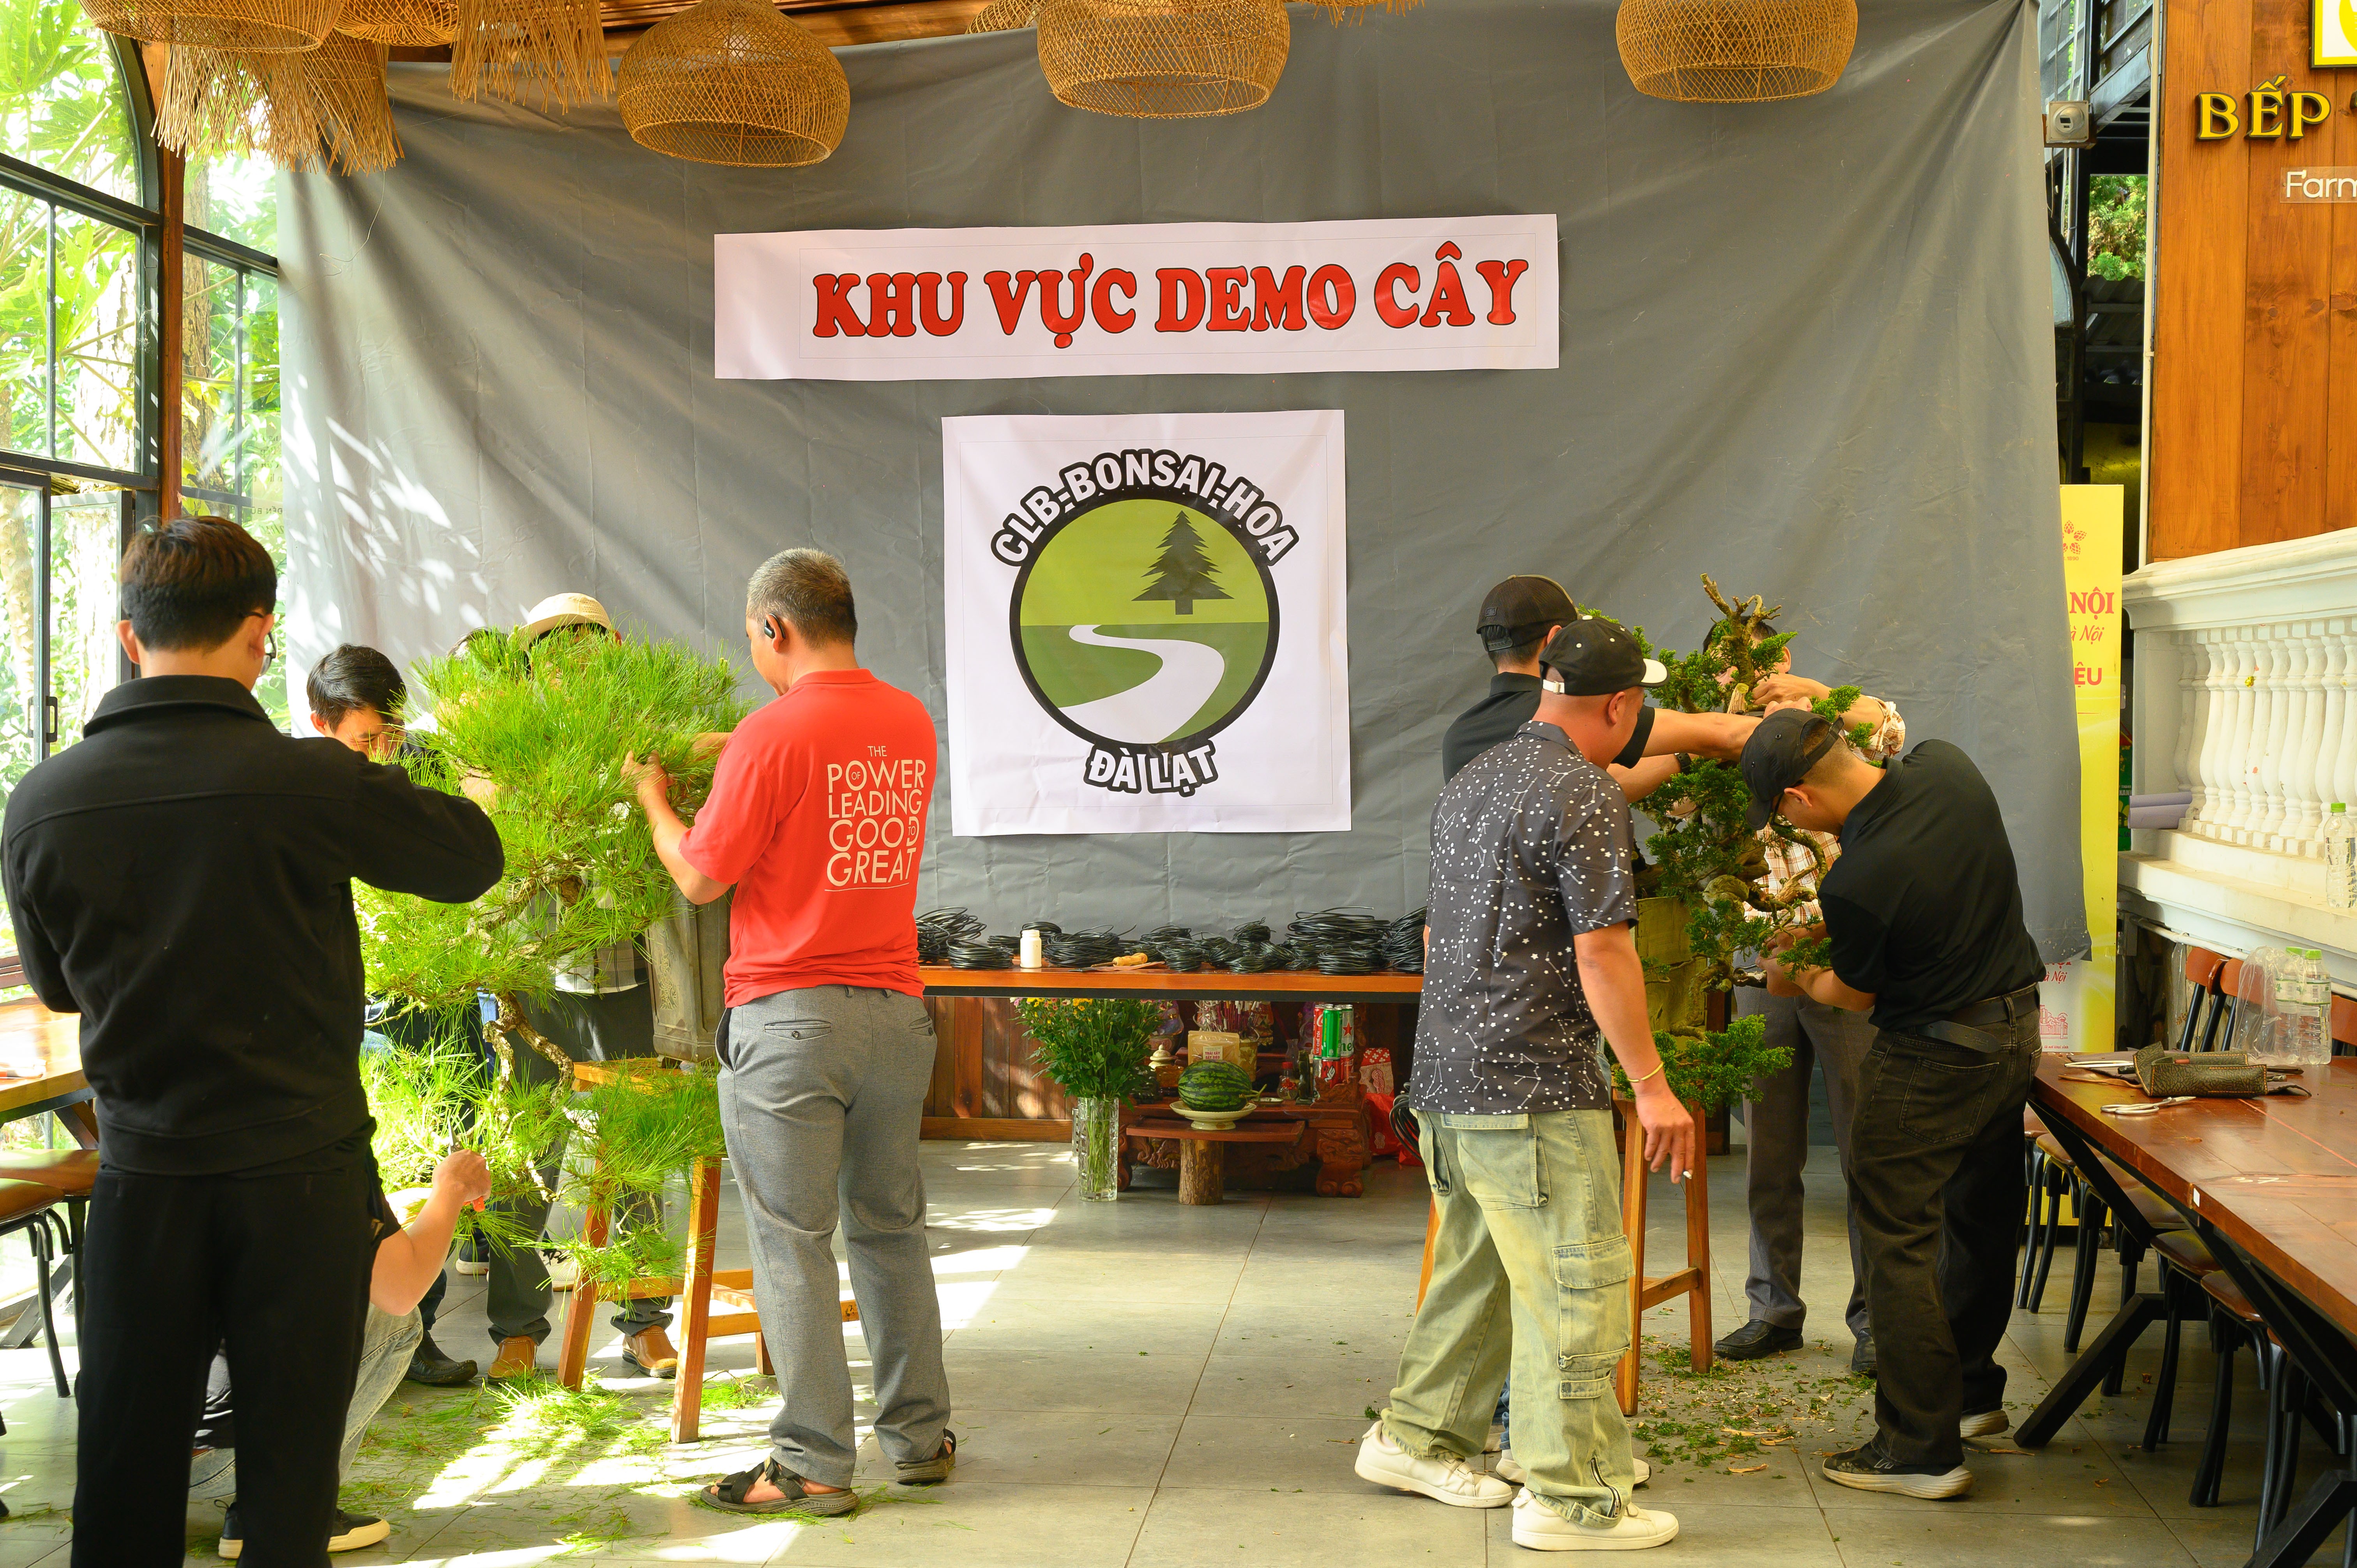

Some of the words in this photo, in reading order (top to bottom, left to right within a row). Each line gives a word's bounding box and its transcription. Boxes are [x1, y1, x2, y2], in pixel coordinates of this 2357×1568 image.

[2197, 74, 2331, 139] BẾP
[813, 271, 968, 338] KHU
[983, 252, 1137, 349] VỰC
[1154, 263, 1356, 332] DEMO
[1374, 240, 1529, 329] CÂY
[993, 450, 1297, 563] CLB-BONSAI-HOA
[2069, 586, 2114, 620] NỘI
[2080, 625, 2104, 645] Nội
[868, 745, 887, 757] THE
[1087, 746, 1139, 790] ĐÀ
[1149, 743, 1214, 793] LẠT
[827, 759, 926, 793] POWER
[851, 772, 861, 780] OF
[828, 789, 922, 819] LEADING
[829, 816, 920, 852] GOOD
[908, 826, 916, 836] TO
[826, 847, 917, 887] GREAT
[2051, 971, 2067, 984] Nội
